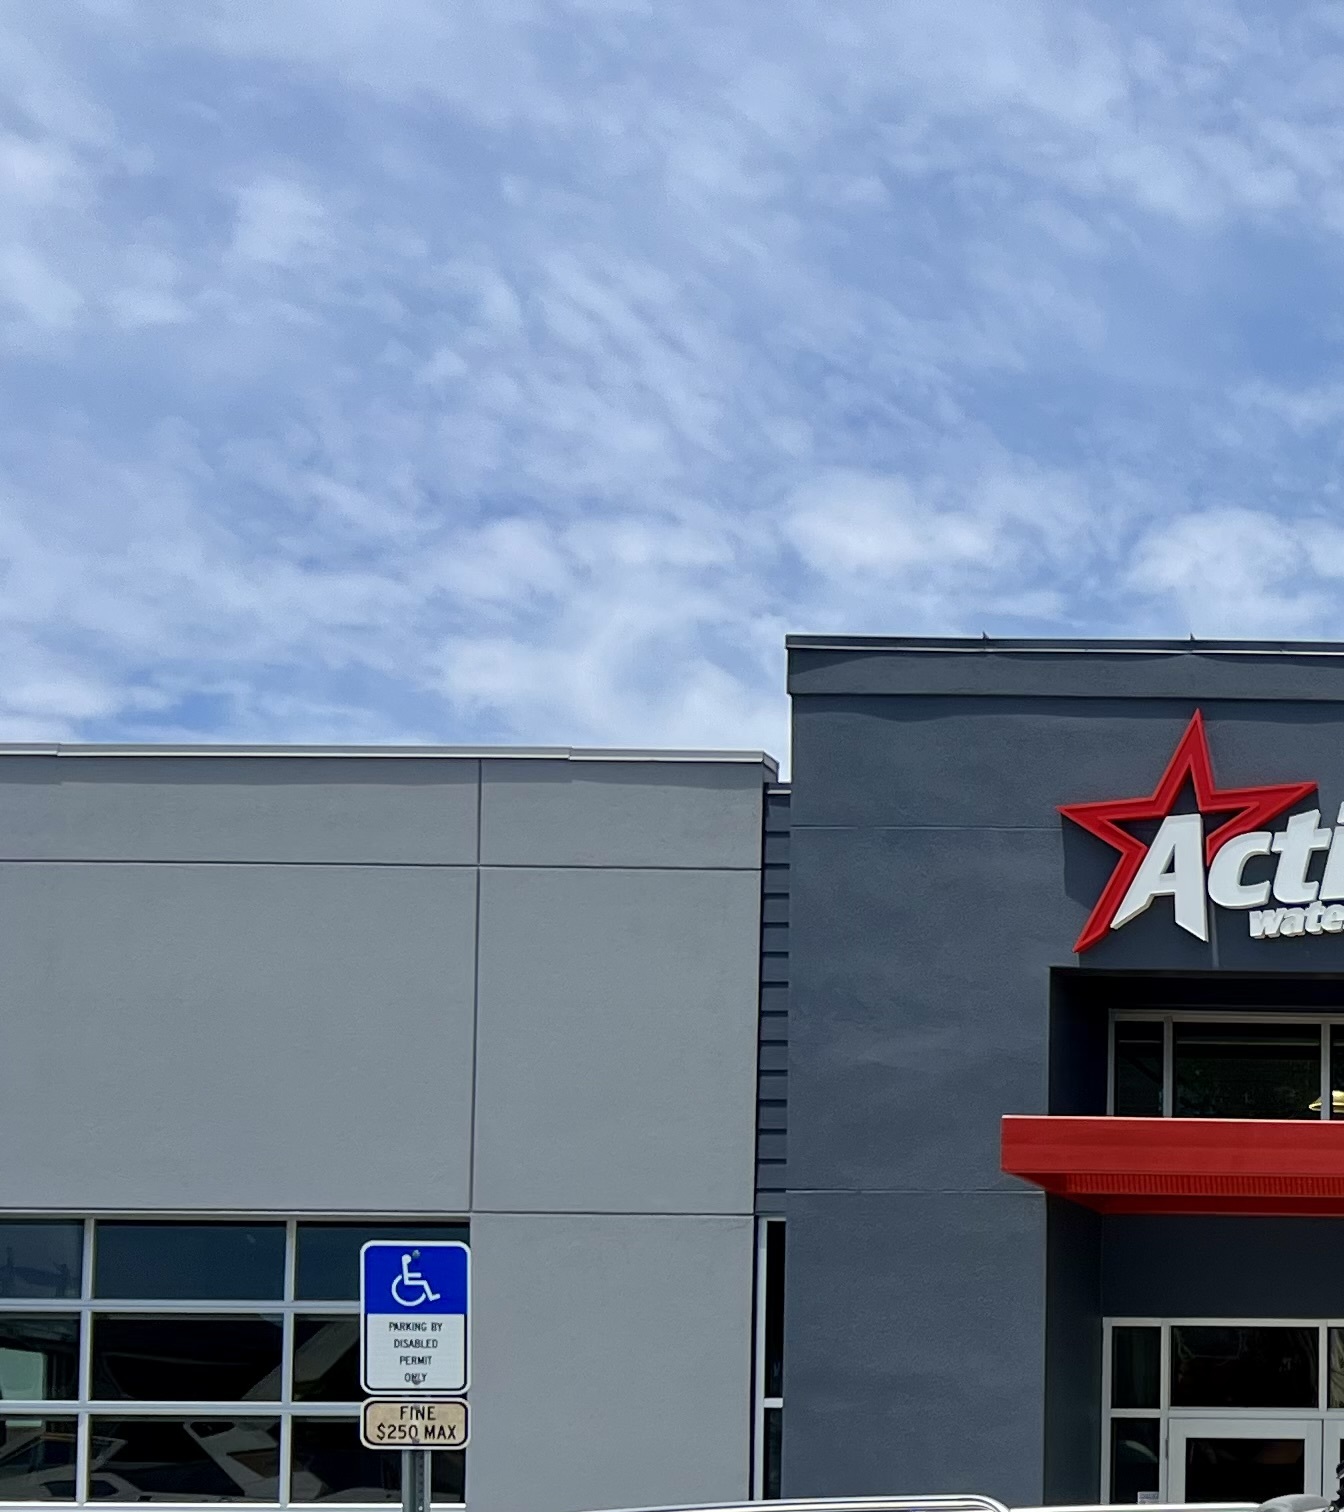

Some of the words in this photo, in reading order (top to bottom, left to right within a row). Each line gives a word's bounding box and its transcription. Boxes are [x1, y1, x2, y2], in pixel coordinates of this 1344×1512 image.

[388, 1321, 427, 1332] PARKING
[430, 1321, 443, 1332] BY
[393, 1338, 438, 1349] DISABLED
[399, 1355, 432, 1365] PERMIT
[399, 1405, 437, 1421] FINE
[376, 1422, 419, 1441] $250
[424, 1424, 457, 1440] MAX
